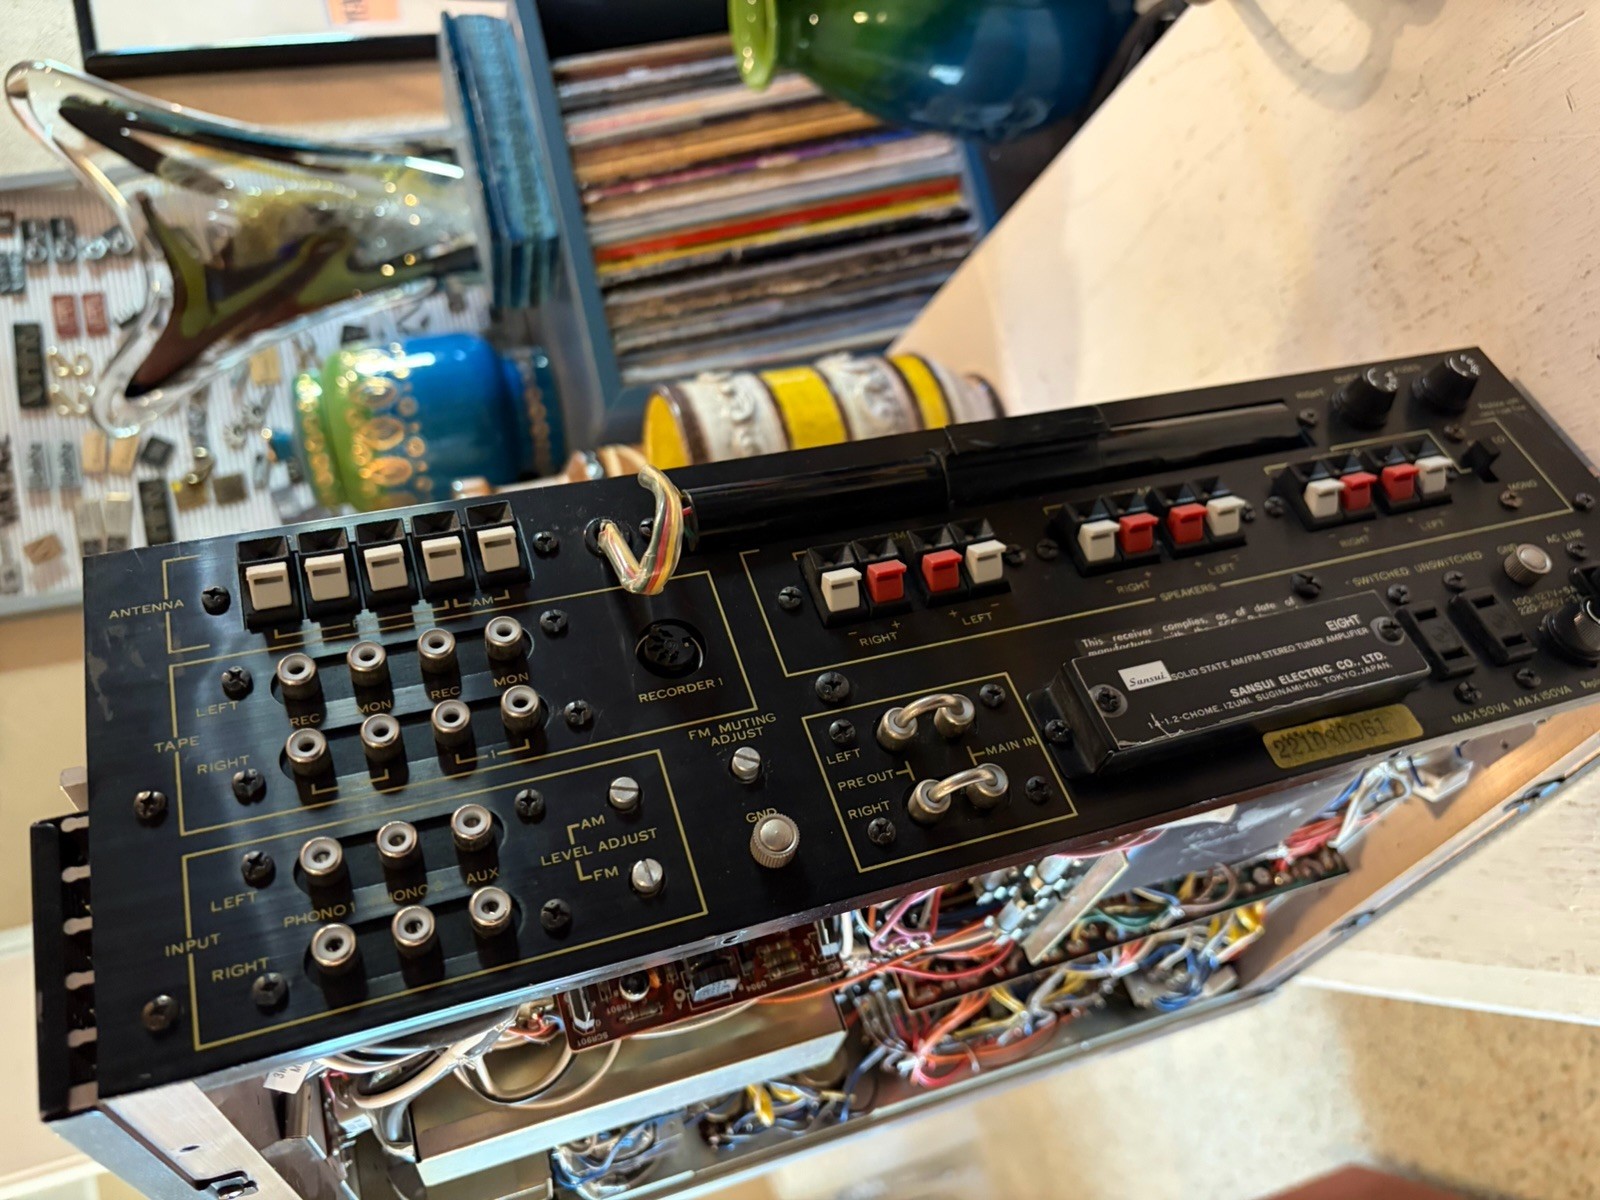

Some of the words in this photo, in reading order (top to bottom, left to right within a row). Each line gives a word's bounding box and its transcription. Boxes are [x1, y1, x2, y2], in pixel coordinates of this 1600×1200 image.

[1420, 518, 1445, 532] LEFT
[1339, 534, 1370, 549] RIGHT
[1207, 561, 1236, 576] LEFT
[1414, 551, 1483, 573] UNSWITCHED
[1352, 566, 1410, 587] SWITCHED
[1116, 579, 1150, 595] RIGHT
[1159, 583, 1218, 601] SPEAKERS
[108, 598, 185, 620] ANTENNA
[471, 595, 495, 607] AM
[961, 611, 993, 626] LEFT
[1081, 637, 1104, 649] This
[1112, 627, 1153, 643] receiver
[1162, 616, 1209, 632] complies,
[1215, 612, 1228, 621] as
[1235, 605, 1247, 617] of
[1254, 602, 1277, 612] date
[1284, 595, 1296, 607] of
[1325, 613, 1362, 632] EIGHT
[859, 631, 898, 648] RIGHT
[1171, 667, 1199, 681] SOLID
[1199, 662, 1230, 675] STATE
[1230, 650, 1262, 667] AM/FM
[1261, 644, 1296, 660] STEREO
[1296, 638, 1325, 651] TUNER
[1325, 626, 1369, 646] AMPLIFIER
[493, 672, 530, 688] MON
[1129, 670, 1167, 687] Sansui
[1230, 678, 1277, 698] SANSUI
[1279, 662, 1334, 686] ELECTRIC
[1361, 651, 1387, 667] LTD.
[430, 685, 462, 700] REC
[638, 679, 715, 704] RECORDER
[195, 700, 240, 718] LEFT
[357, 699, 393, 715] MON
[289, 713, 322, 728] REC
[688, 726, 711, 741] FM
[718, 712, 777, 736] MUTING
[154, 735, 200, 754] TAPE
[710, 726, 765, 747] ADJUST
[985, 739, 1020, 757] MAIN
[1022, 735, 1038, 748] IN
[196, 754, 250, 775] RIGHT
[826, 747, 862, 766] LEFT
[837, 775, 866, 792] PRE
[866, 768, 895, 786] OUT
[745, 807, 778, 825] GND
[847, 799, 892, 821] RIGHT
[580, 814, 606, 831] AM
[540, 845, 593, 867] LEVEL
[597, 826, 659, 853] ADJUST
[466, 866, 500, 885] AUX
[593, 865, 620, 882] FM
[210, 891, 258, 913] LEFT
[283, 903, 347, 929] PHONO
[164, 932, 221, 957] INPUT
[211, 956, 270, 983] RIGHT
[576, 1030, 609, 1047] SCR901
